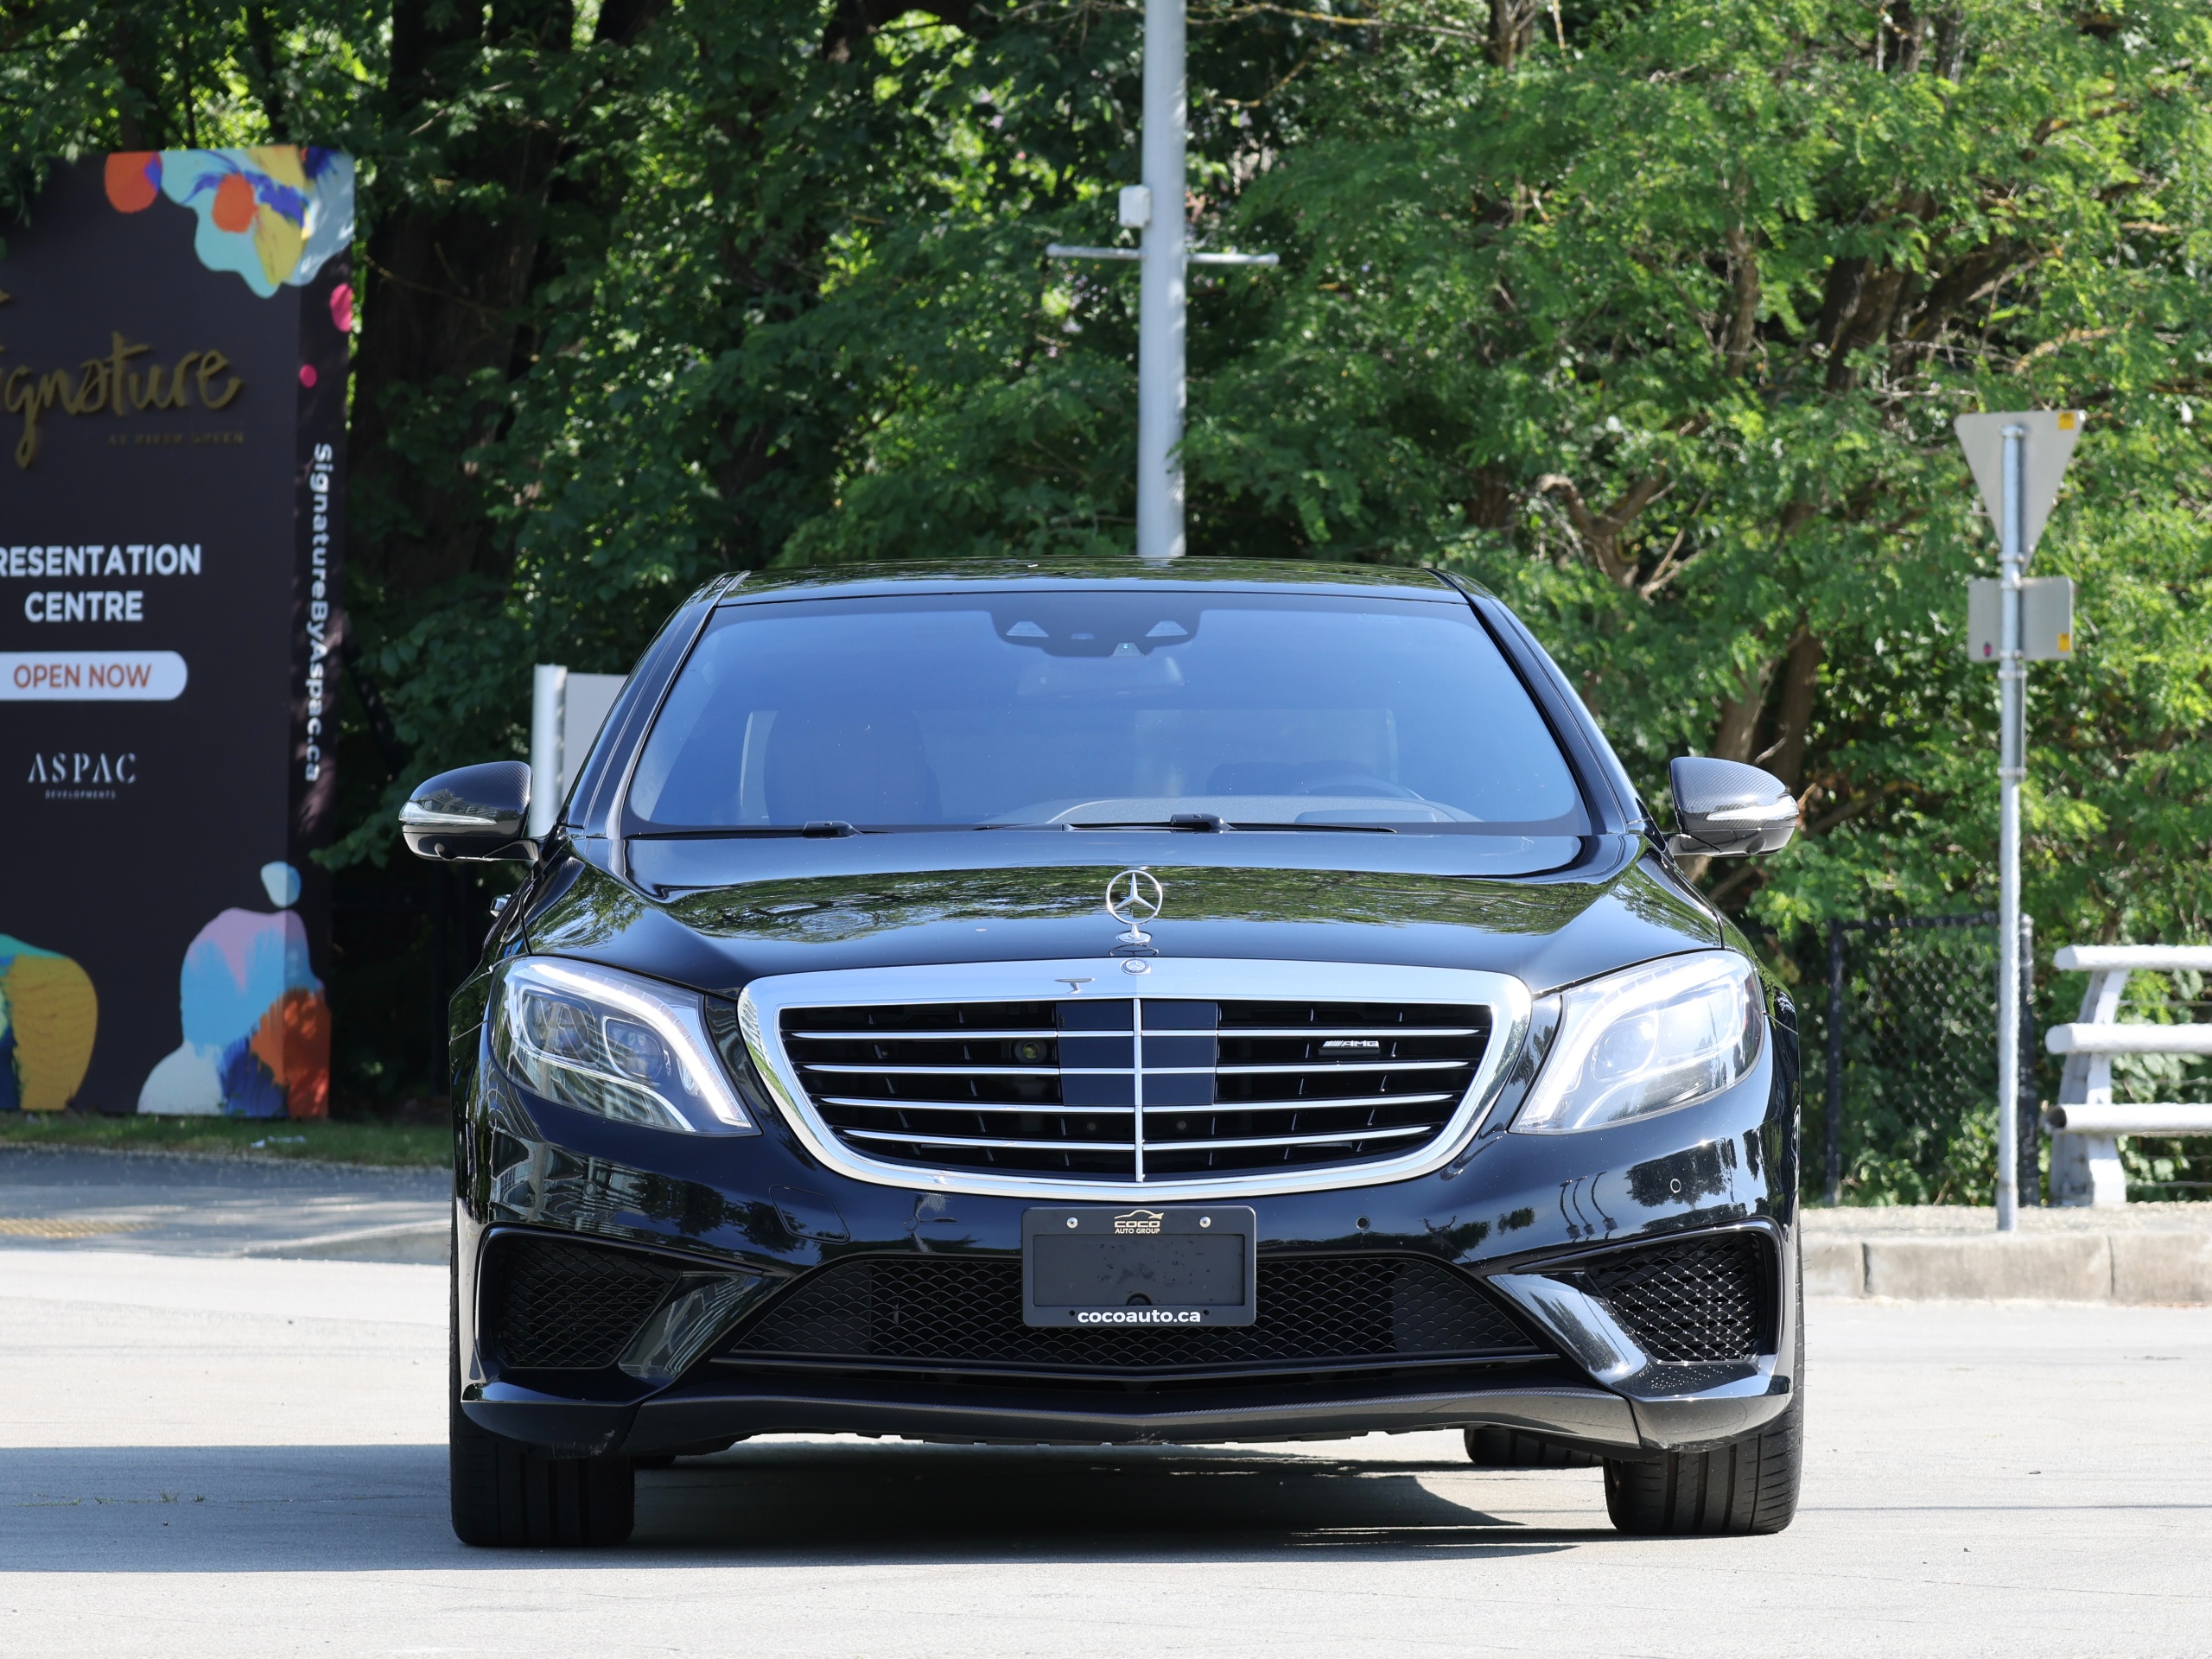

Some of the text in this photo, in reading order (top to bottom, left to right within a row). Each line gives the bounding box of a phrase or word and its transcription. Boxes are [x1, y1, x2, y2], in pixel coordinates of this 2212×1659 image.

[0, 289, 245, 468] gnature
[191, 432, 245, 444] GREEN
[24, 590, 143, 622] CENTRE
[305, 442, 334, 781] SignatureByAspac.ca
[13, 664, 152, 689] OPEN NOW
[28, 753, 137, 784] ASPAC
[45, 789, 116, 799] DEVELOPMENTS
[1341, 1039, 1380, 1048] AMG
[1077, 1309, 1201, 1323] cocoauto.ca
